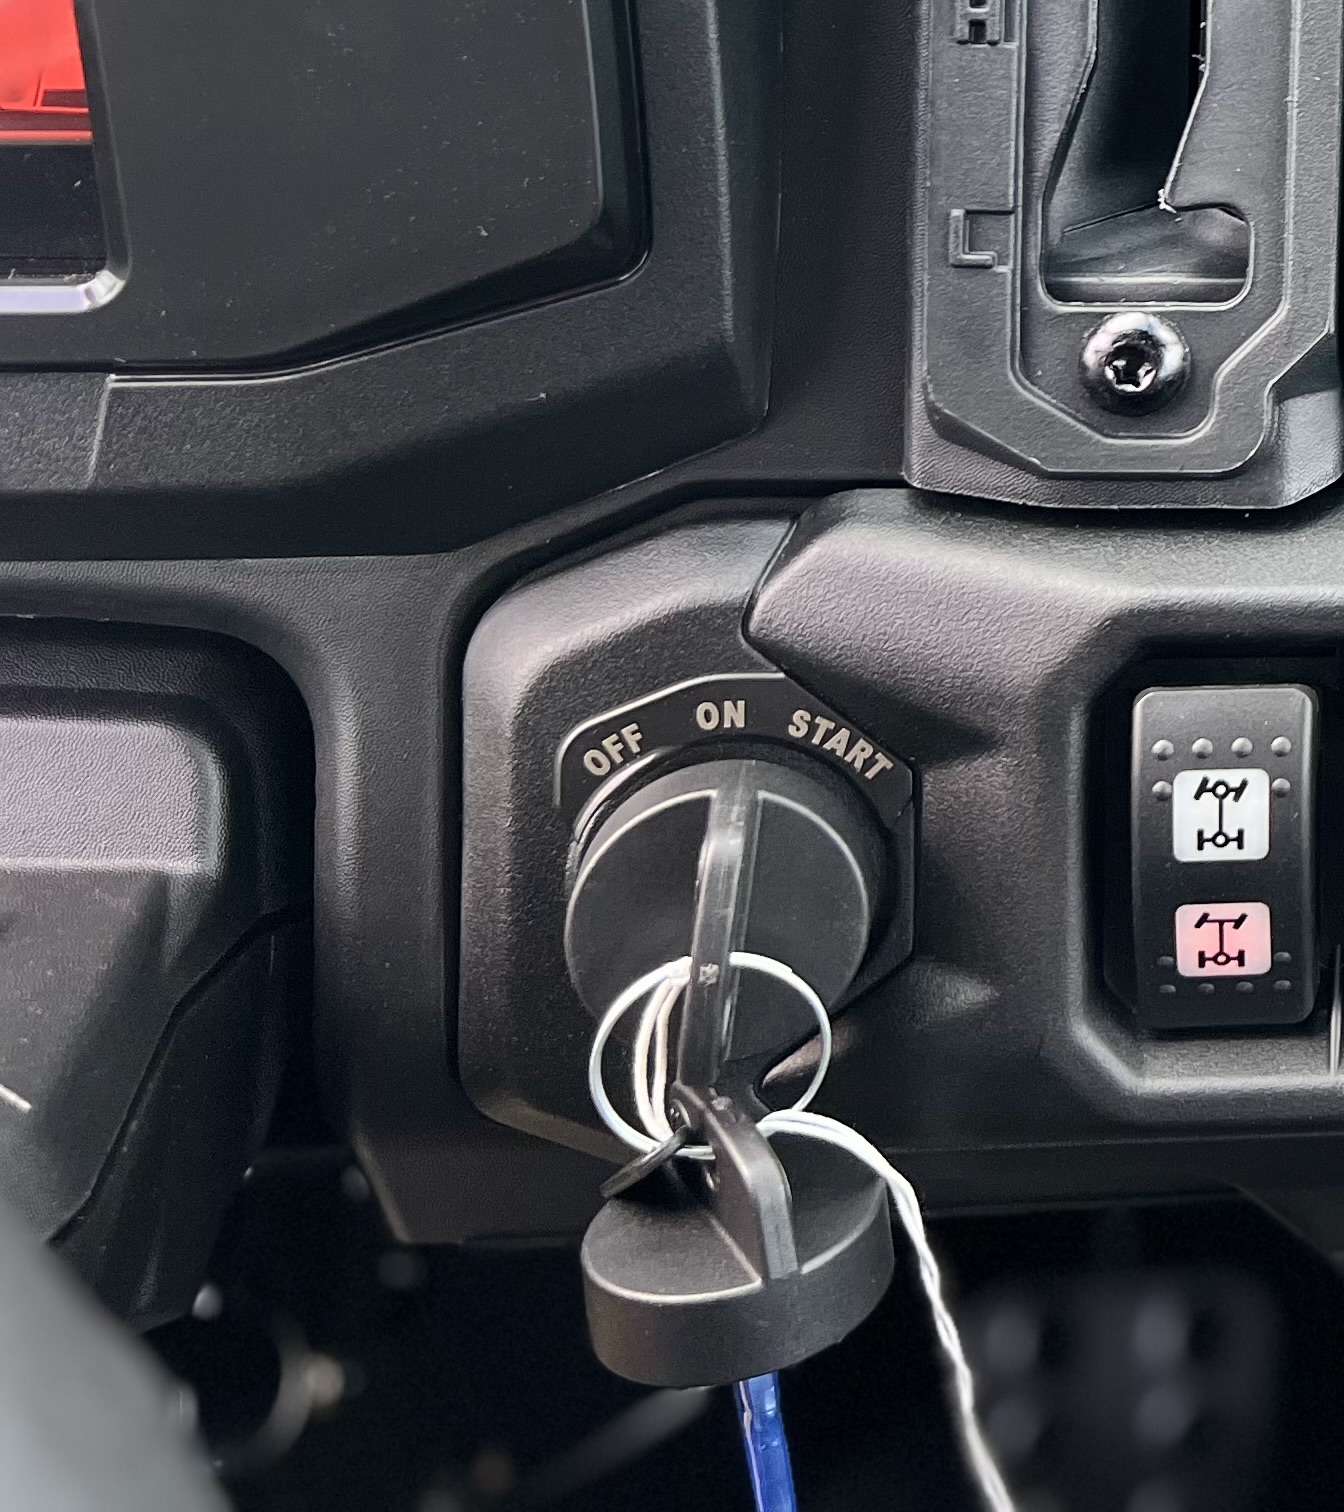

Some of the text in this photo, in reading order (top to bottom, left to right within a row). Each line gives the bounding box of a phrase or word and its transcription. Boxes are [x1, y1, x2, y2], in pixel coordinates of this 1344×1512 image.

[949, 208, 997, 268] L
[583, 700, 894, 780] OFF ON START
